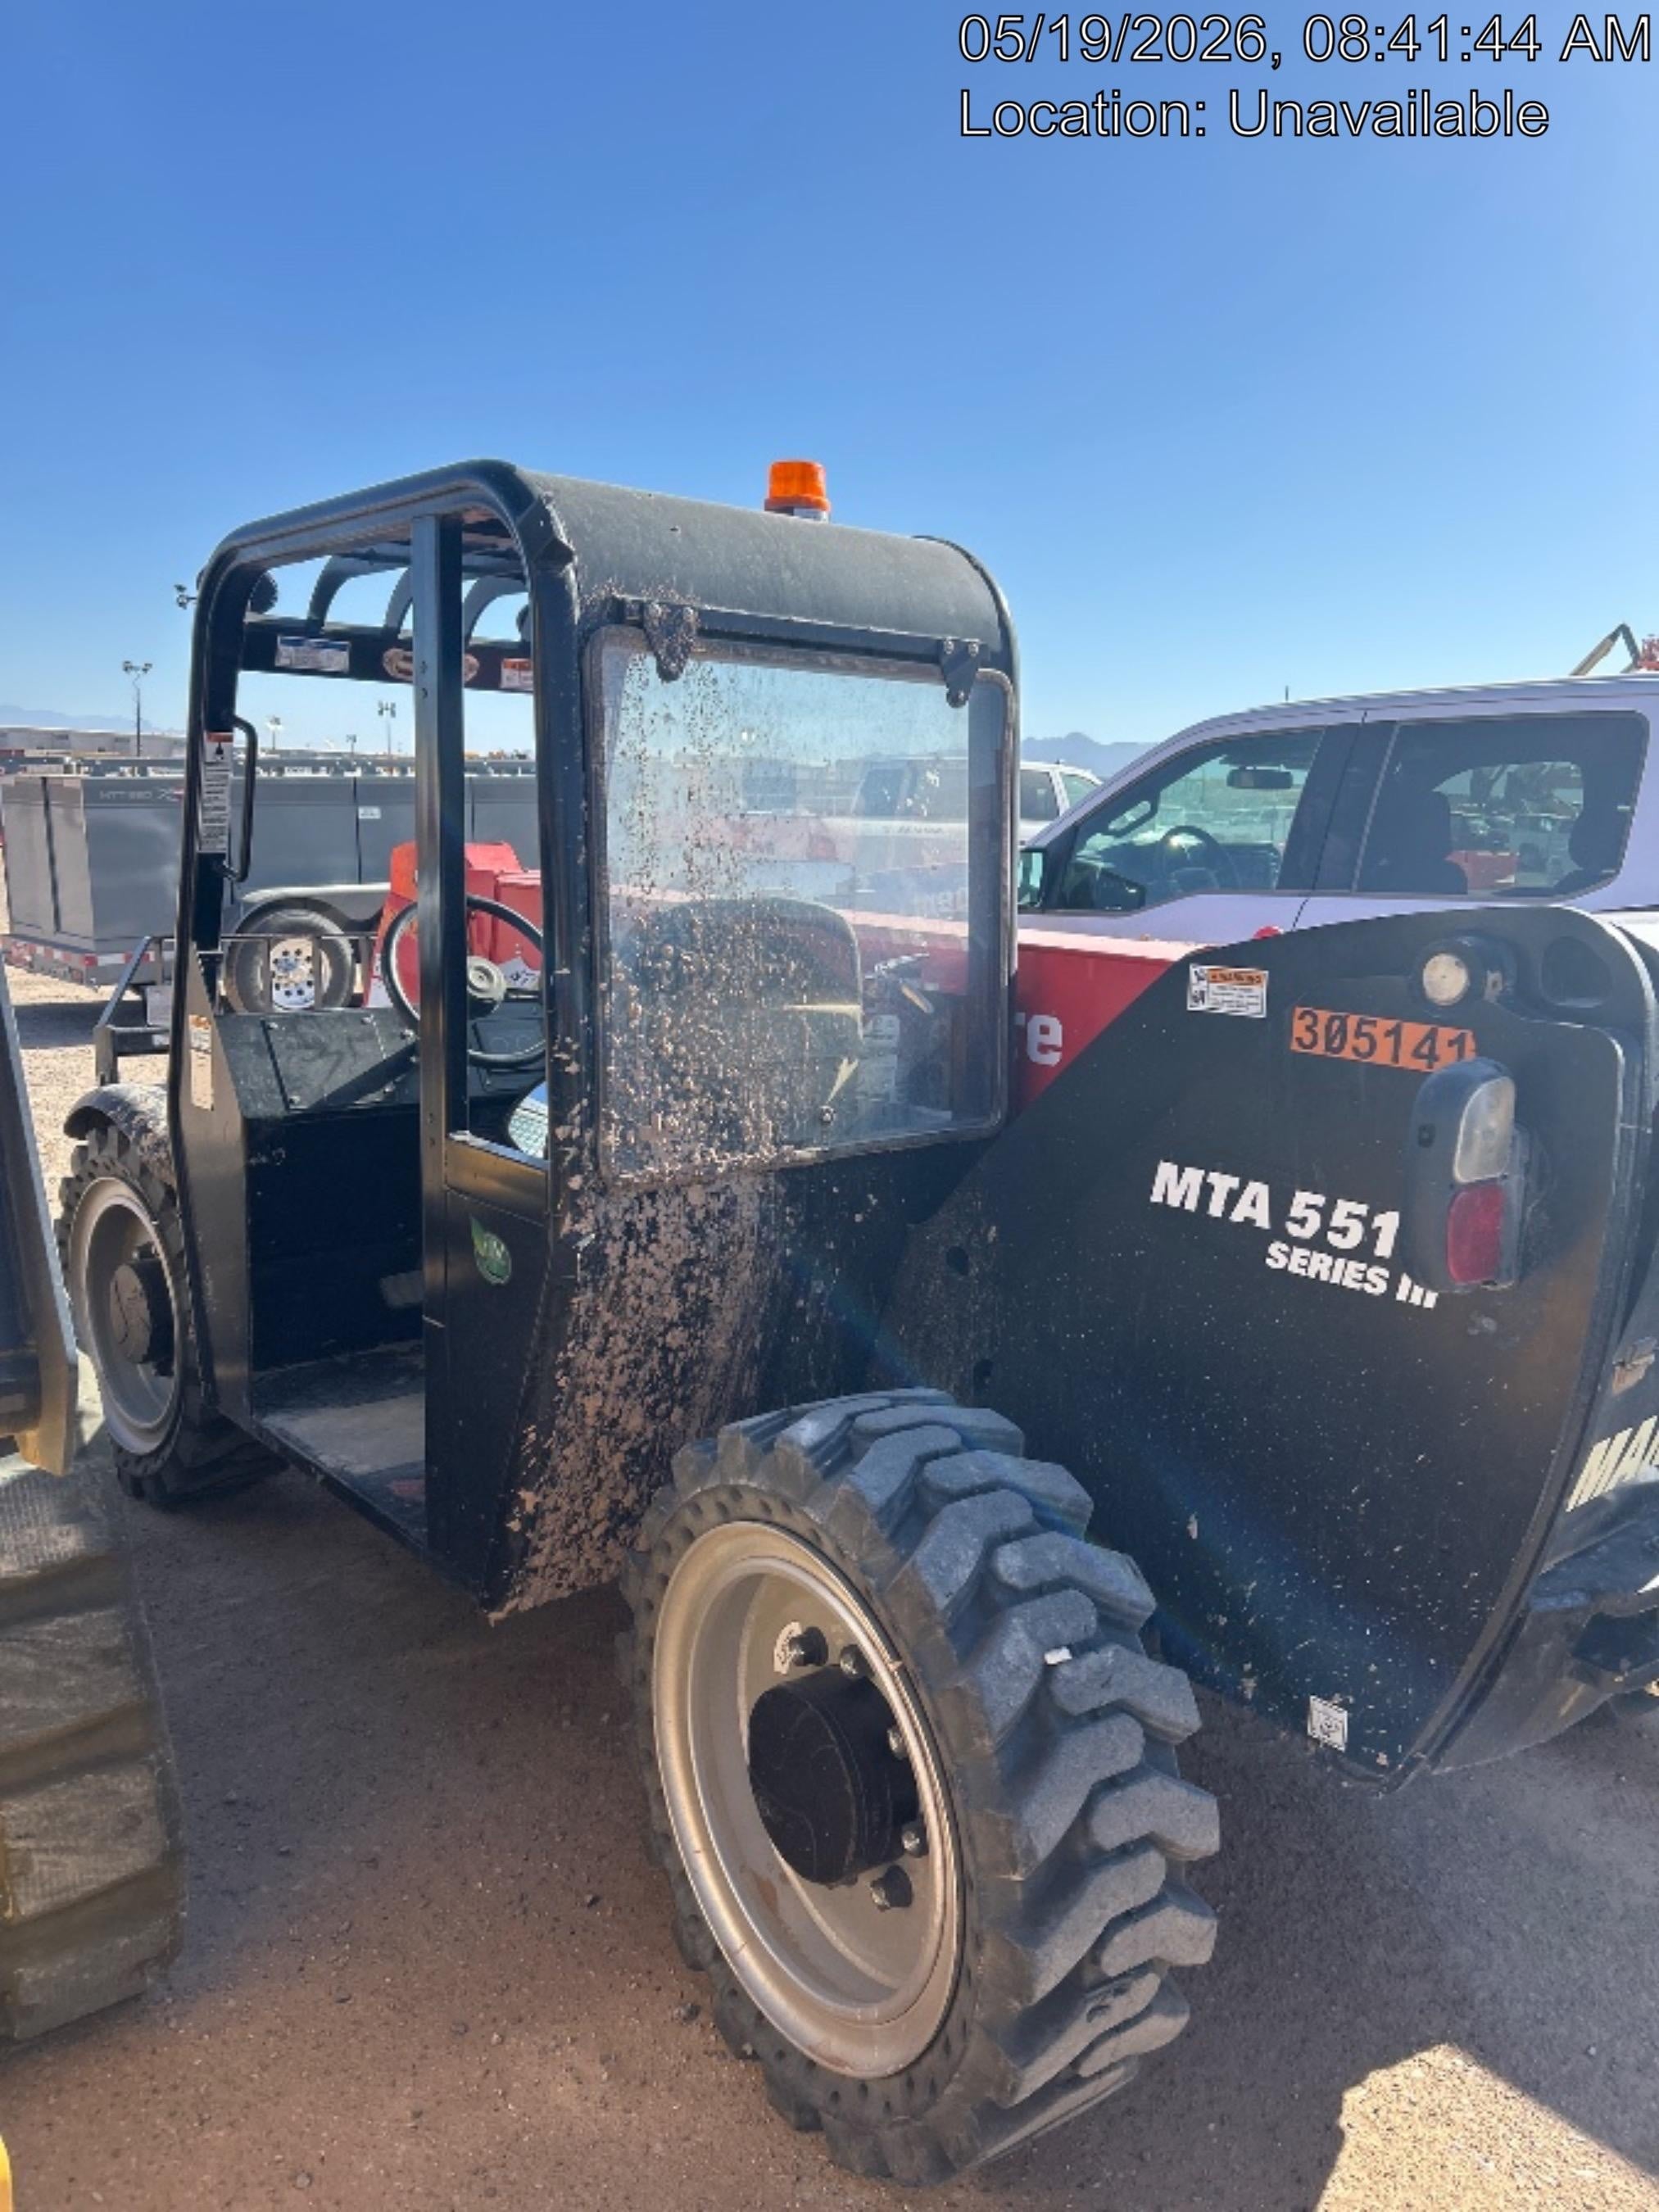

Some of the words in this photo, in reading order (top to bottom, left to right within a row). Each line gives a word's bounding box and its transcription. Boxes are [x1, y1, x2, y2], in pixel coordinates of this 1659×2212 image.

[1294, 1009, 1468, 1070] 305141
[1150, 1159, 1270, 1229] MTA
[1285, 1190, 1401, 1259] 551
[1266, 1240, 1389, 1296] SERIES
